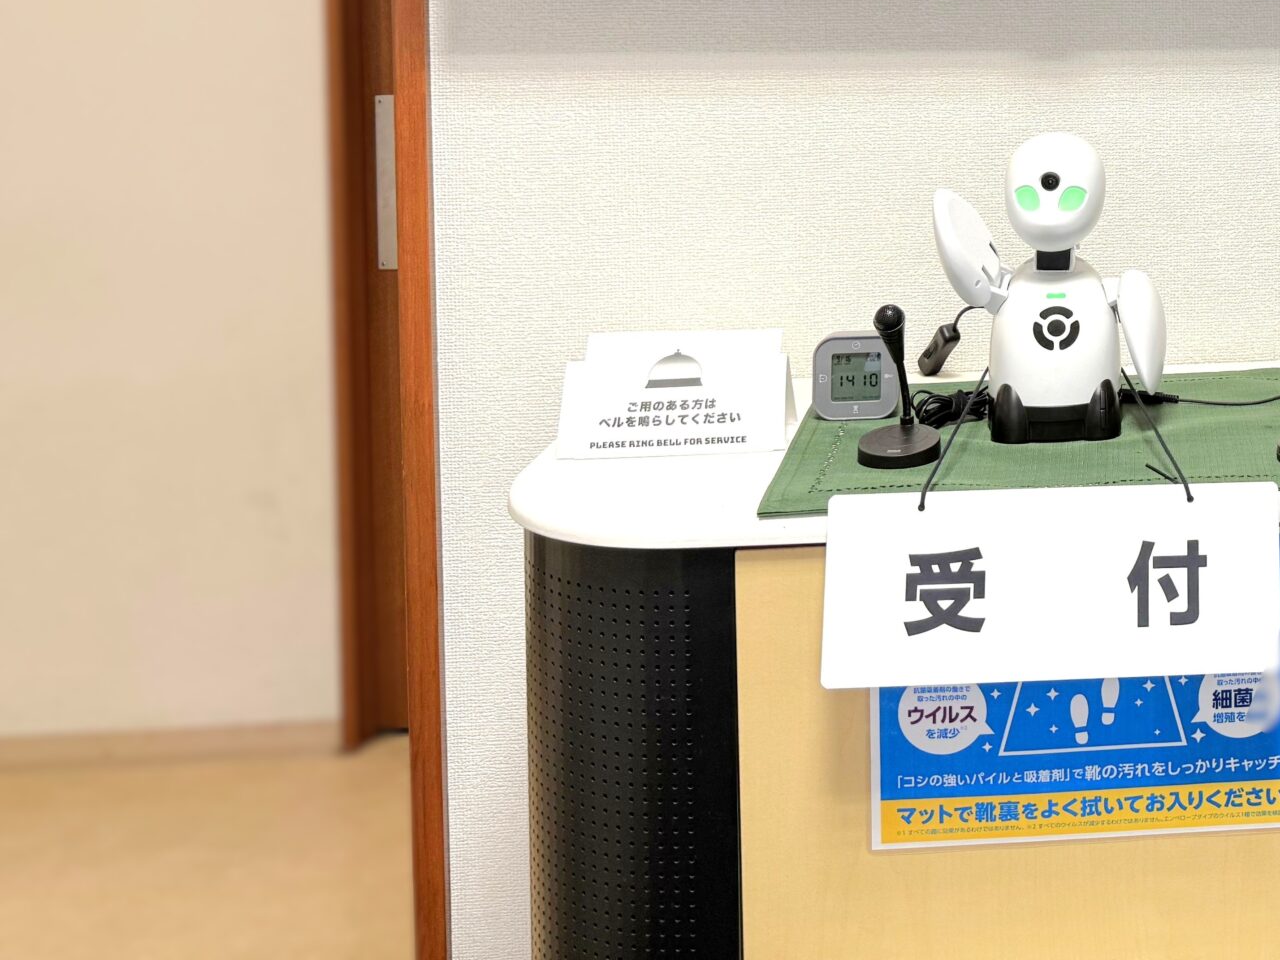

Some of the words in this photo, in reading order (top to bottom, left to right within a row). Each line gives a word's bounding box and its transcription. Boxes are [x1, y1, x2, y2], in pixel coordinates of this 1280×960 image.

[627, 398, 716, 413] ご用のある方は
[599, 412, 741, 428] ベルを鳴らしてください
[589, 441, 627, 449] PLEASE
[629, 440, 654, 448] RING
[656, 438, 681, 447] BELL
[684, 437, 702, 445] FOR
[705, 436, 747, 445] SERVICE
[907, 705, 977, 725] ウイルス
